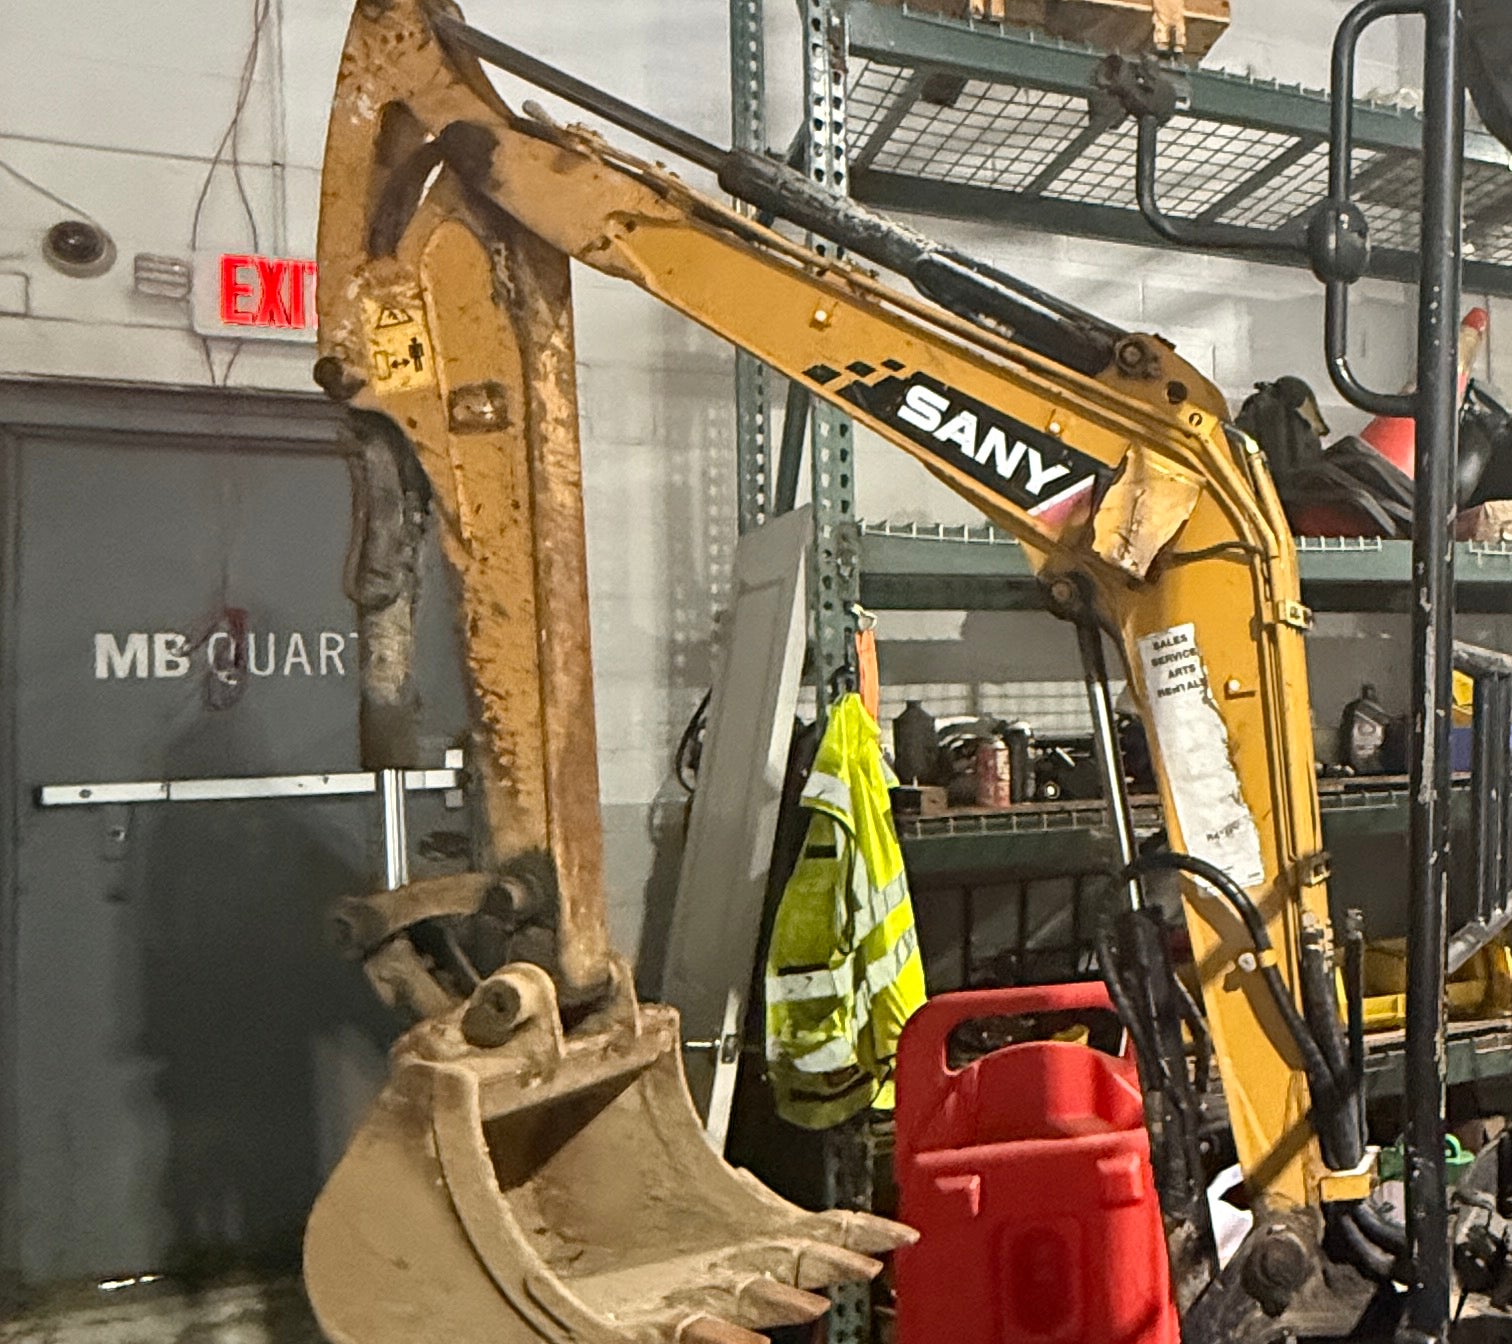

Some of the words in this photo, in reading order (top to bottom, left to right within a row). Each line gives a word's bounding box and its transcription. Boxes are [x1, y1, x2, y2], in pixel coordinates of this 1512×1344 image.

[220, 254, 318, 329] EXI
[897, 384, 1071, 496] SANY
[94, 632, 190, 679] MB
[207, 631, 359, 686] QUAR
[1151, 647, 1198, 667] SERVICE
[1153, 634, 1188, 651] SALES
